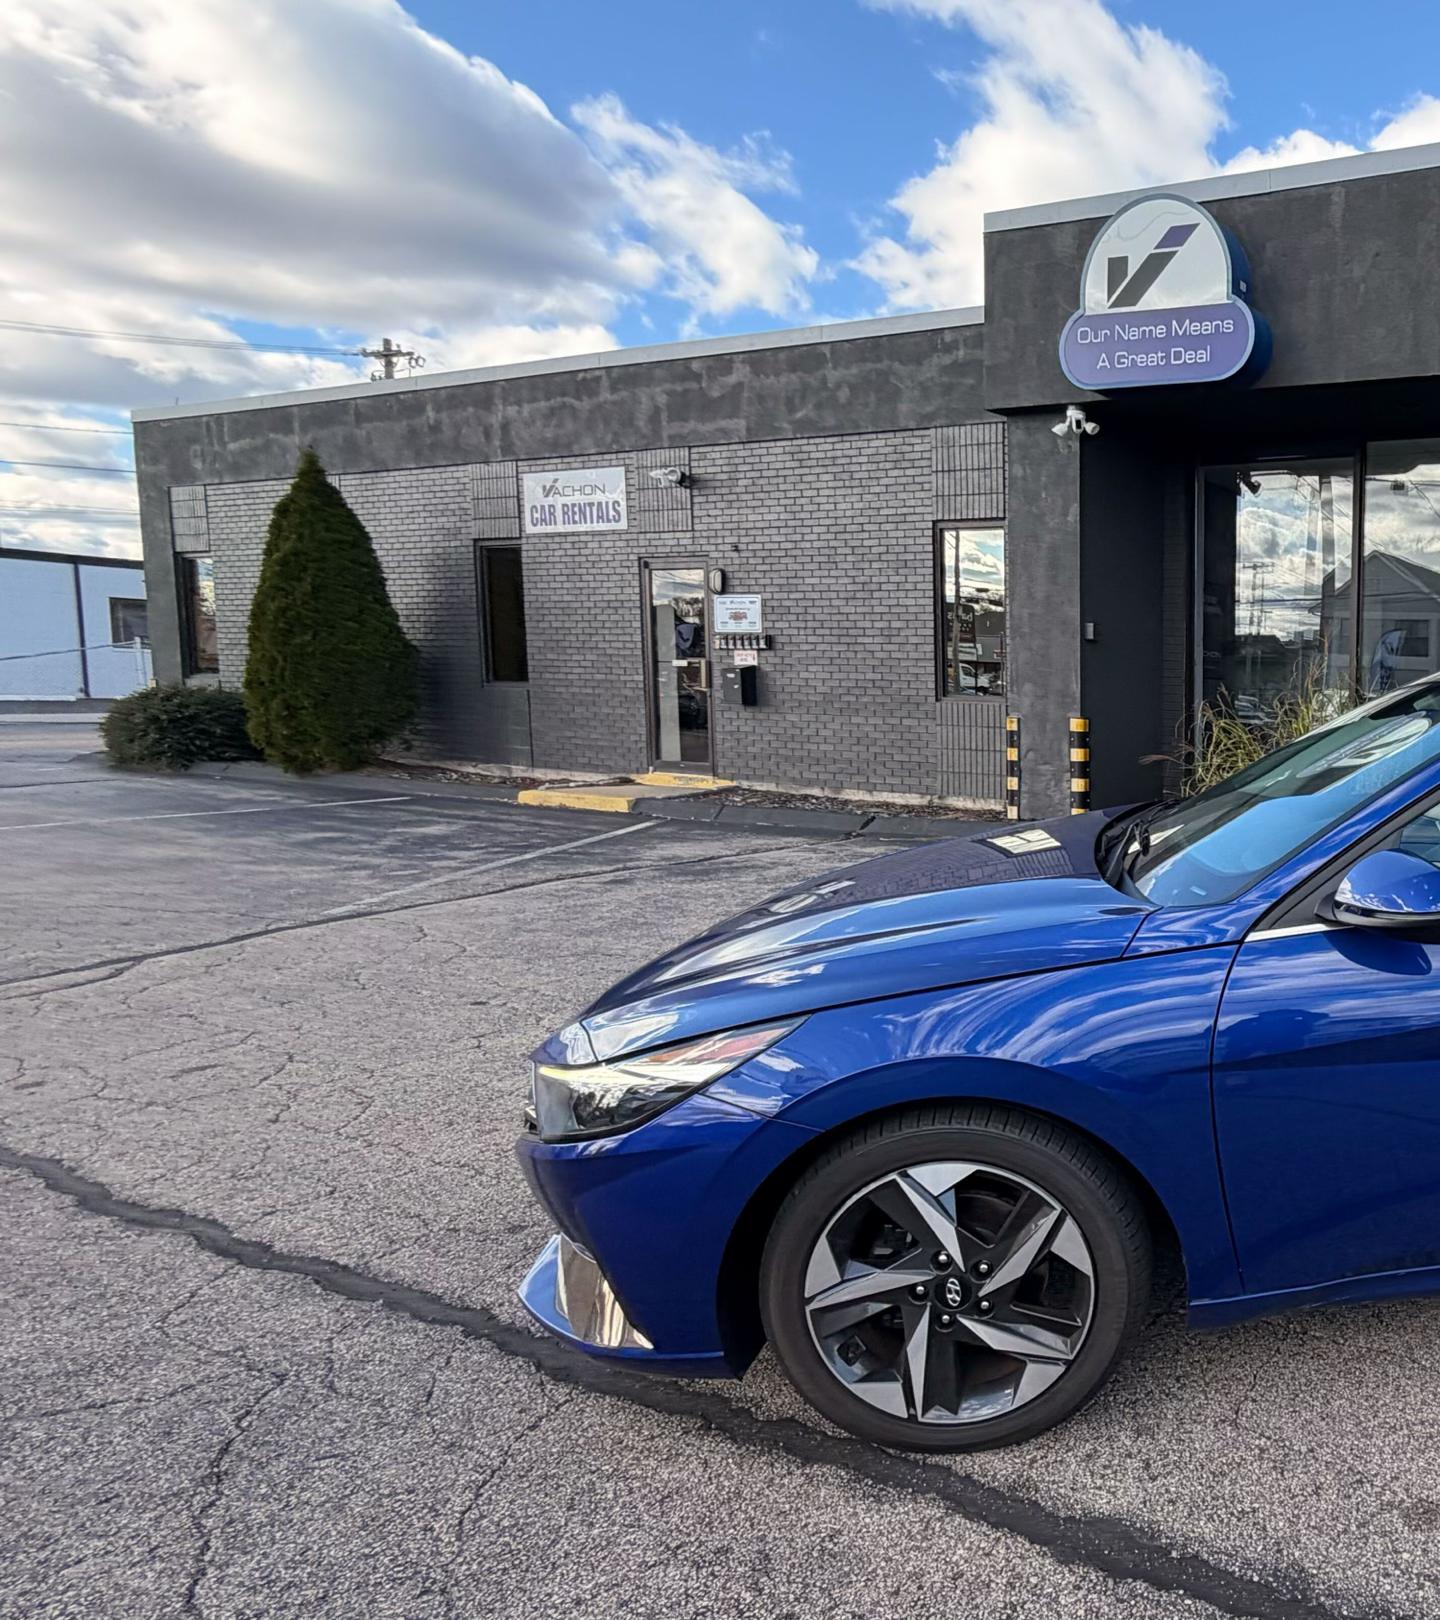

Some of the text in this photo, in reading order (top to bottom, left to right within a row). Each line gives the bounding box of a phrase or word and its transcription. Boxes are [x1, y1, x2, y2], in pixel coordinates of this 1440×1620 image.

[1077, 318, 1234, 343] Our Name Means
[1097, 345, 1210, 369] A Great Deal
[542, 478, 605, 498] VACHON
[530, 500, 621, 527] CAR RENTALS
